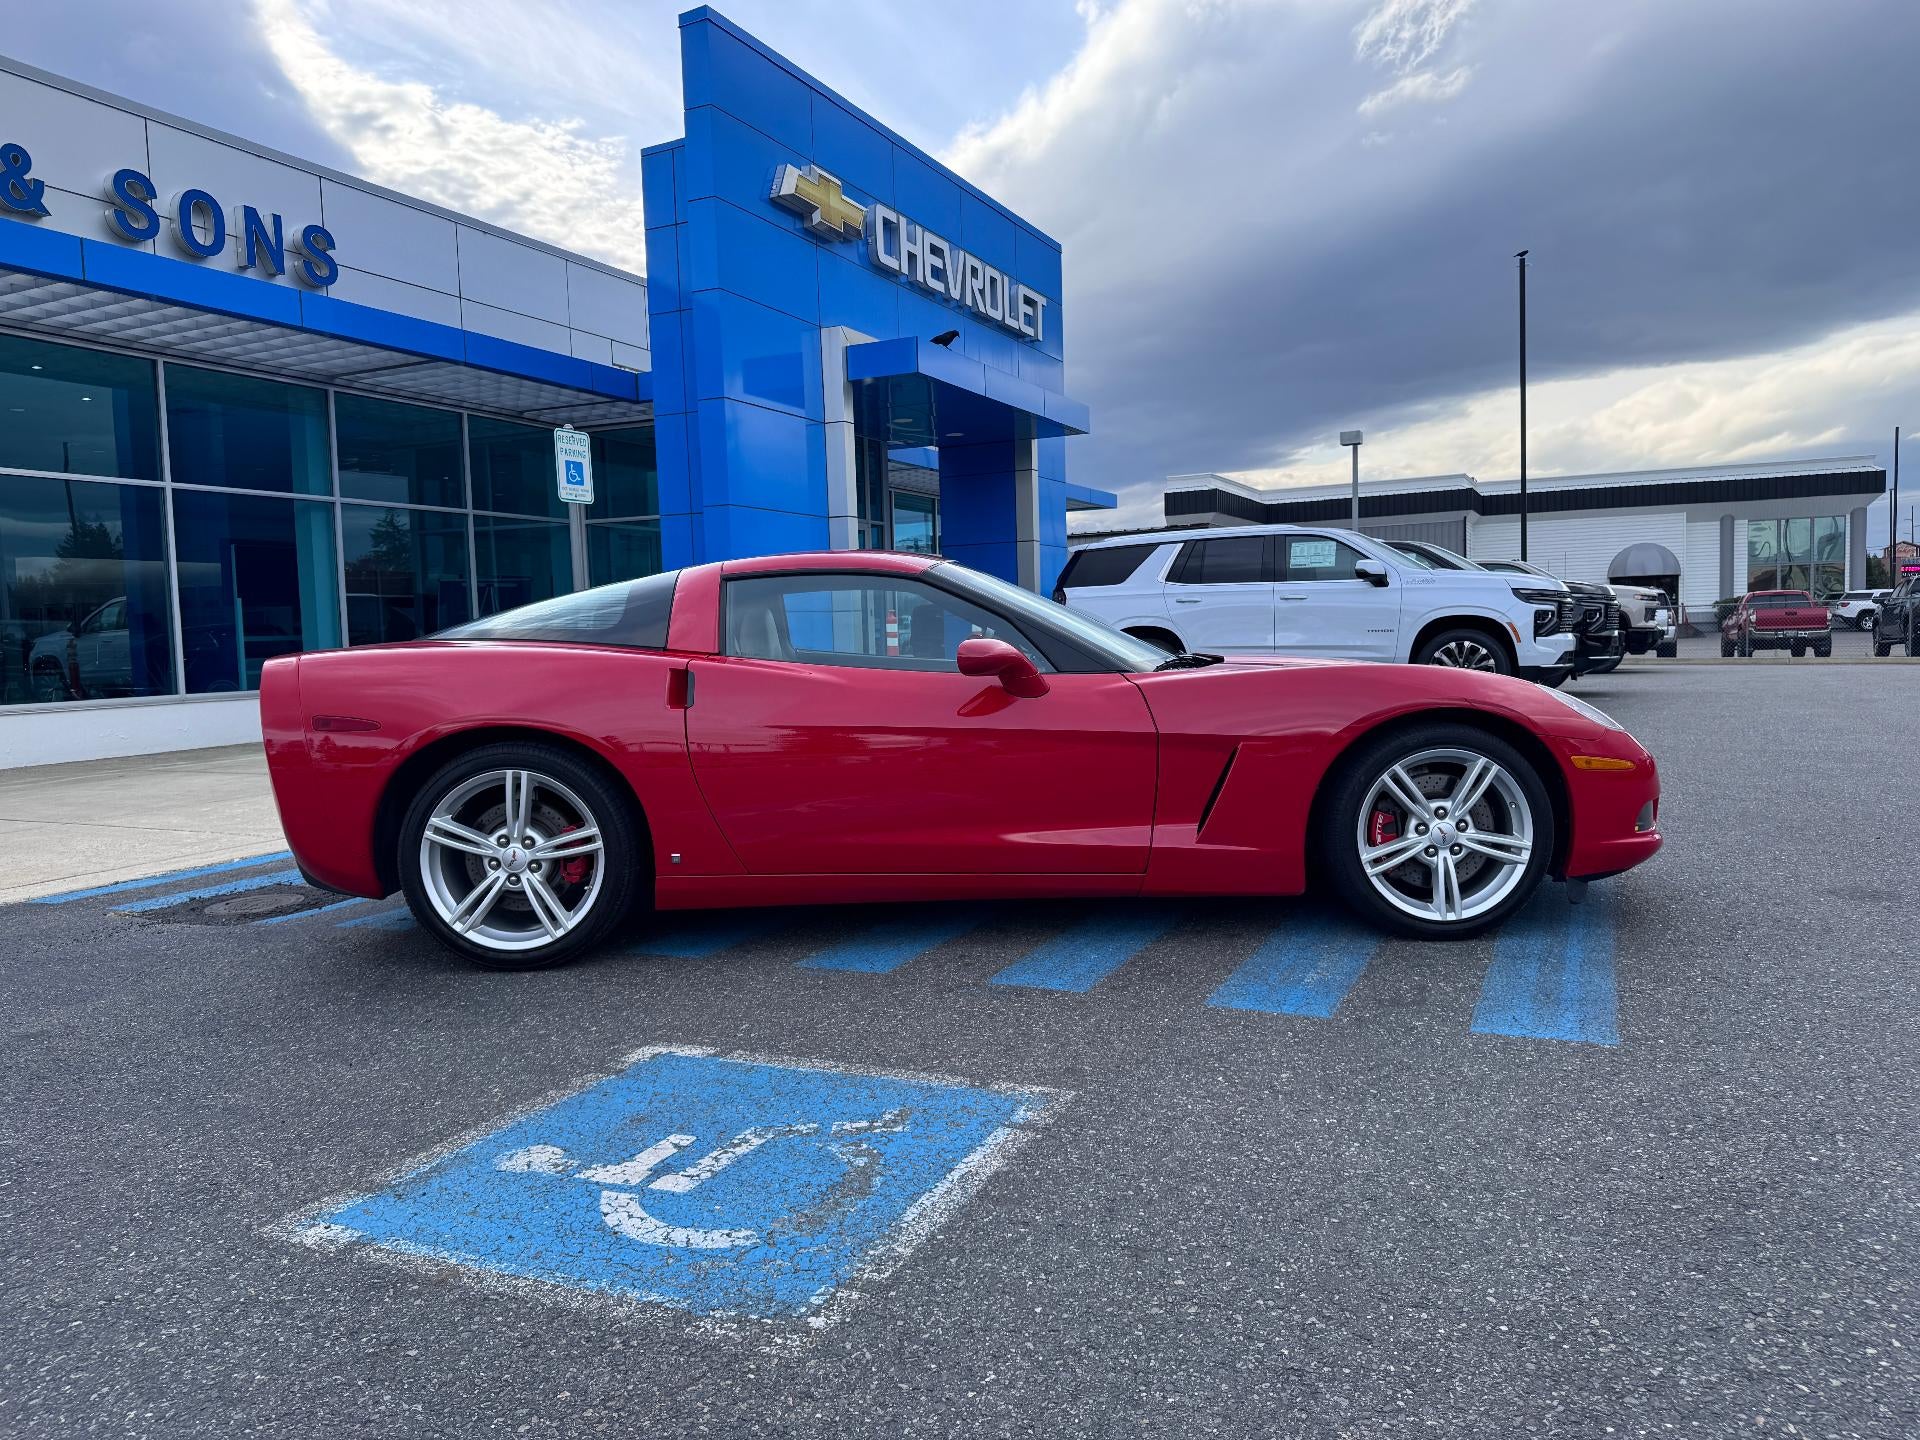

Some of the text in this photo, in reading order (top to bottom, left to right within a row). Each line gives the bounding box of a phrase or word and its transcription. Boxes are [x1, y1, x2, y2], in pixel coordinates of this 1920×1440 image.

[0, 143, 340, 288] & SONS
[867, 203, 1047, 342] CHEVROLET
[558, 434, 586, 447] RESERVED
[560, 447, 586, 458] PARKING
